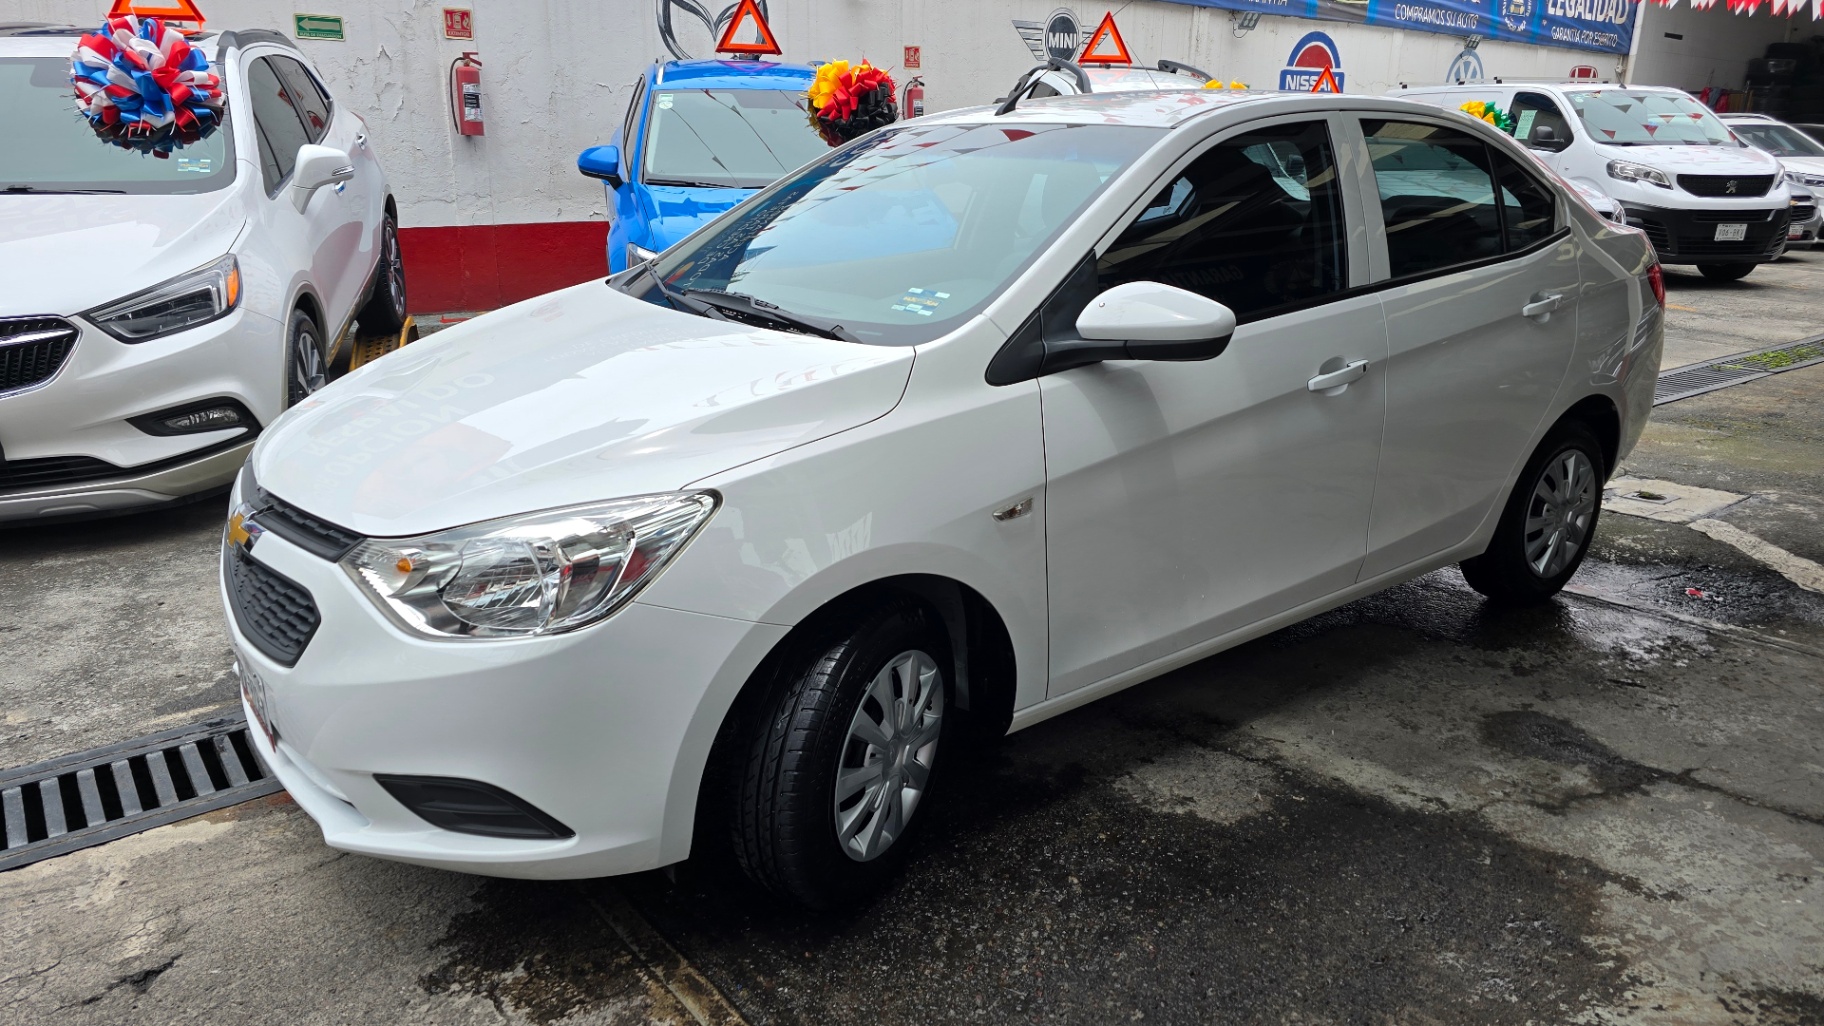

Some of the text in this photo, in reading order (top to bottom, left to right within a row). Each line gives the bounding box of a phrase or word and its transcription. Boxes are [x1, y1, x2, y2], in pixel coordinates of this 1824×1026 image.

[1394, 3, 1446, 25] COMPRAMOS
[1446, 11, 1456, 27] SU
[1048, 32, 1076, 48] MINI
[1551, 26, 1580, 43] GARANTIA
[1580, 30, 1594, 45] POR
